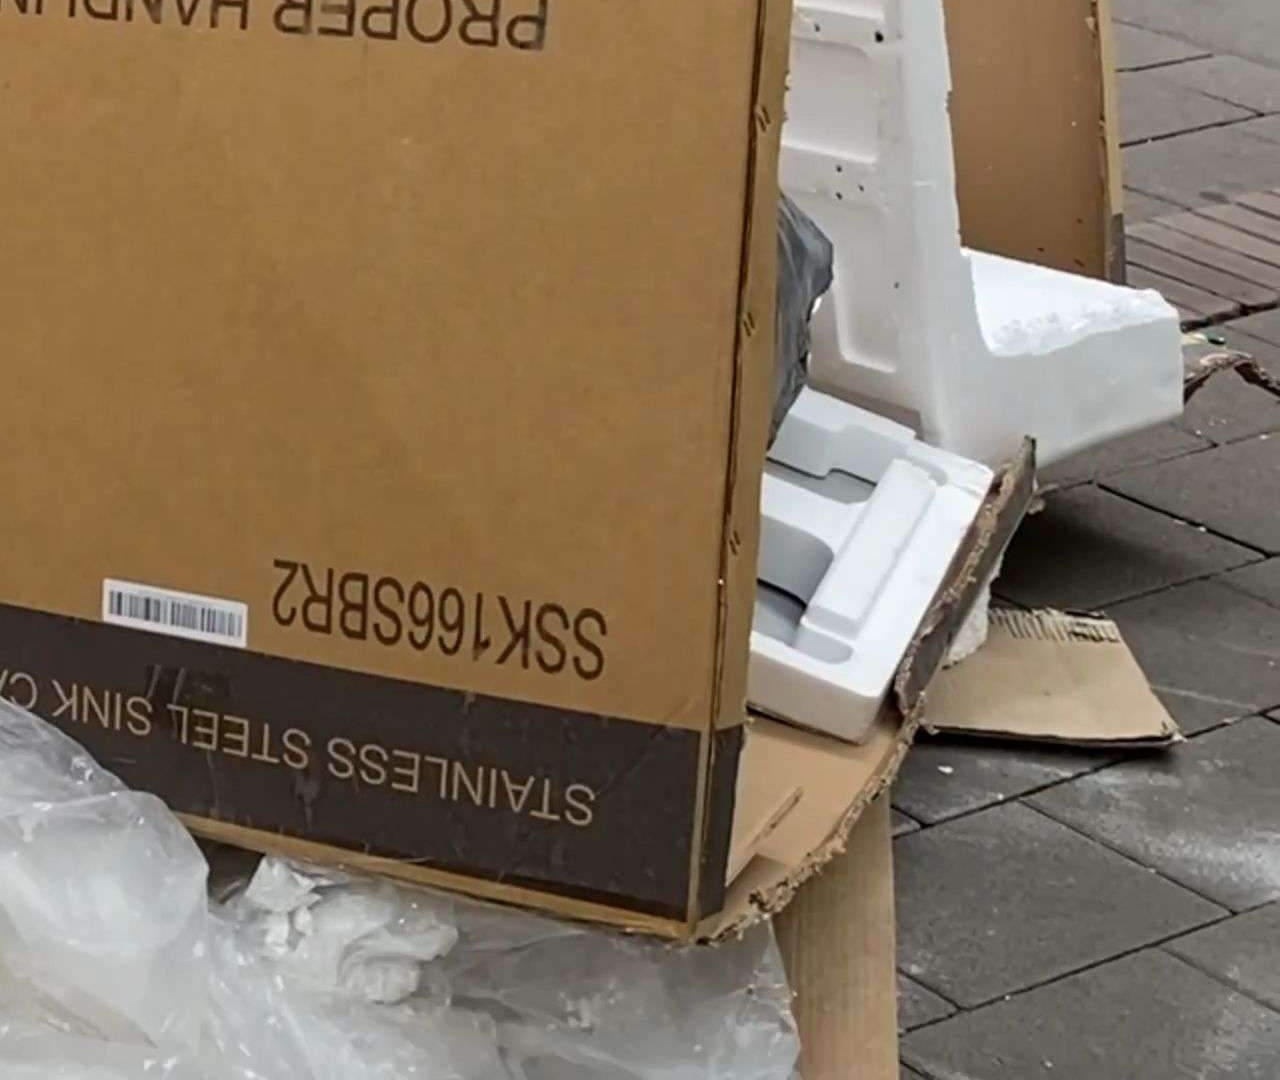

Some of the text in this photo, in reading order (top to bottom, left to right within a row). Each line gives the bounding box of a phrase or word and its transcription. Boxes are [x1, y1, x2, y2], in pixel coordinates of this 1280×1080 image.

[271, 557, 608, 681] SSK166SBR2
[52, 679, 153, 736] SINK
[168, 702, 313, 768] STEEL
[327, 734, 597, 826] STAINLESS
